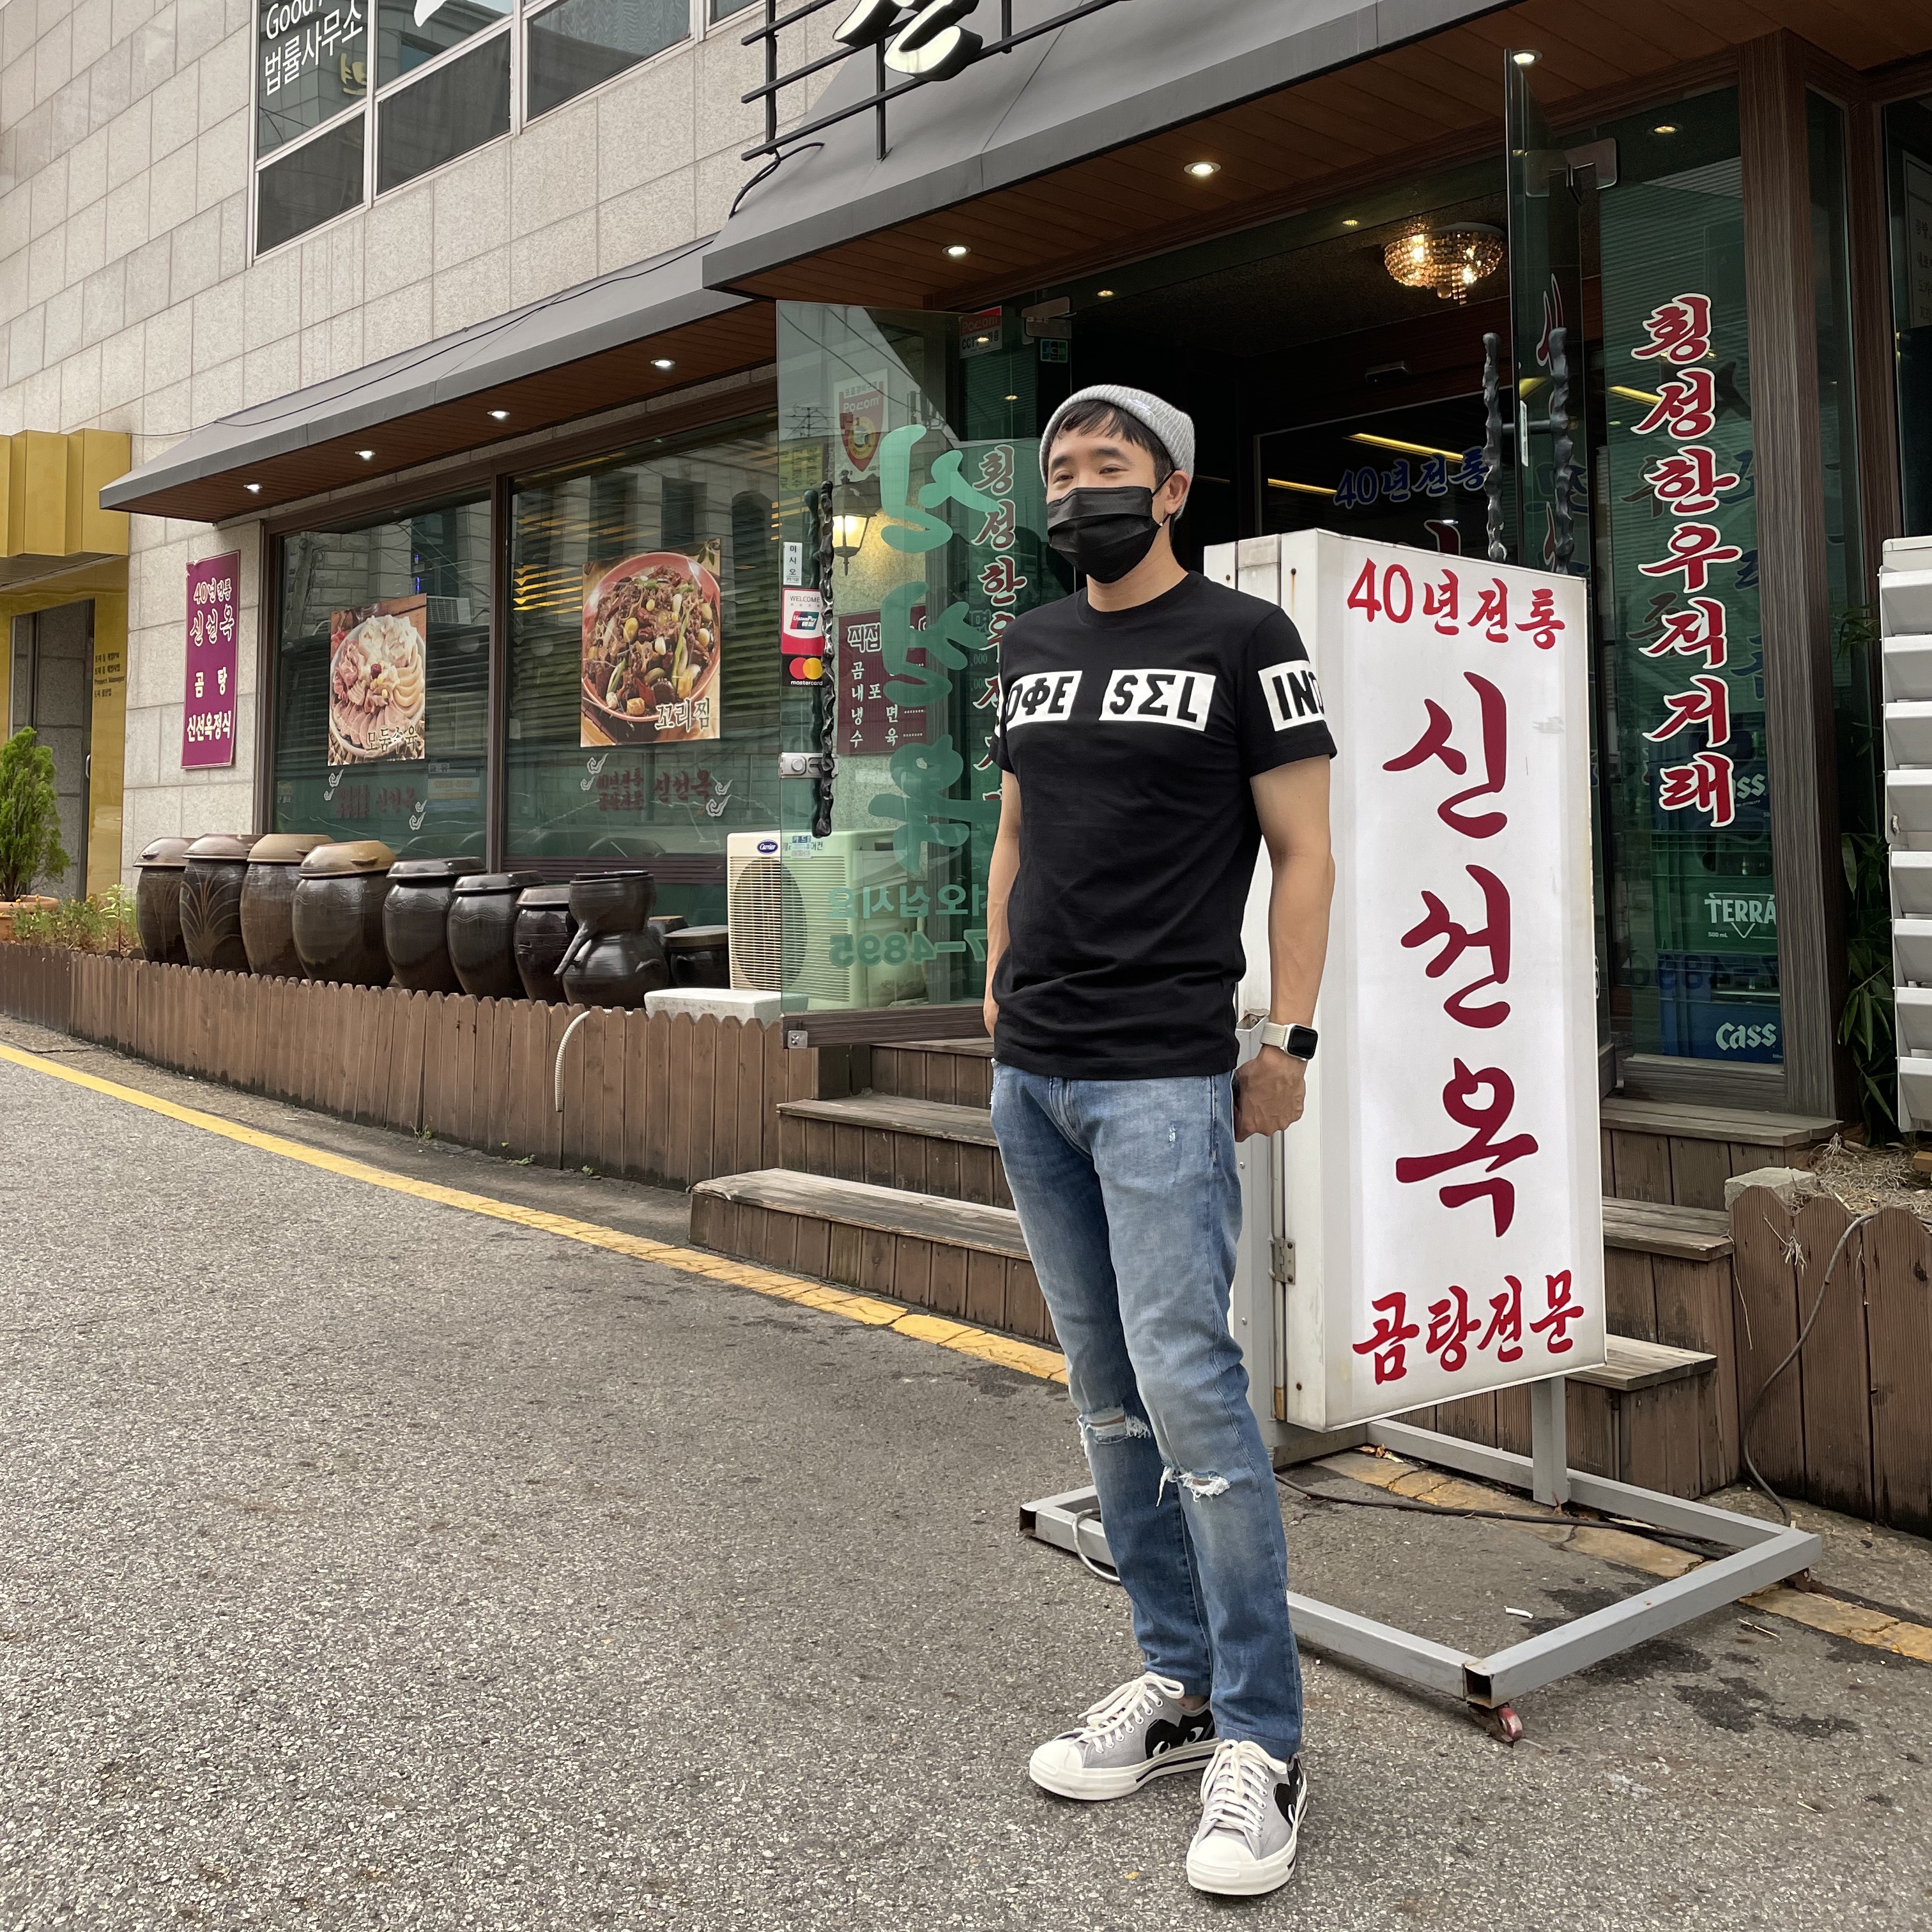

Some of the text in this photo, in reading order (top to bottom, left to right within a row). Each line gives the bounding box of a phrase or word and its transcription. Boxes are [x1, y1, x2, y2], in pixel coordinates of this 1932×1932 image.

[264, 0, 364, 96] 법률사무소
[788, 545, 797, 575] 미시오
[1347, 558, 1566, 650] 40년전통
[187, 710, 232, 742] 신선옥정식
[655, 696, 710, 733] 꼬리찜
[1733, 773, 1766, 799] ss
[1383, 671, 1538, 1238] 신선옥
[1353, 1270, 1585, 1386] 곰탕전문
